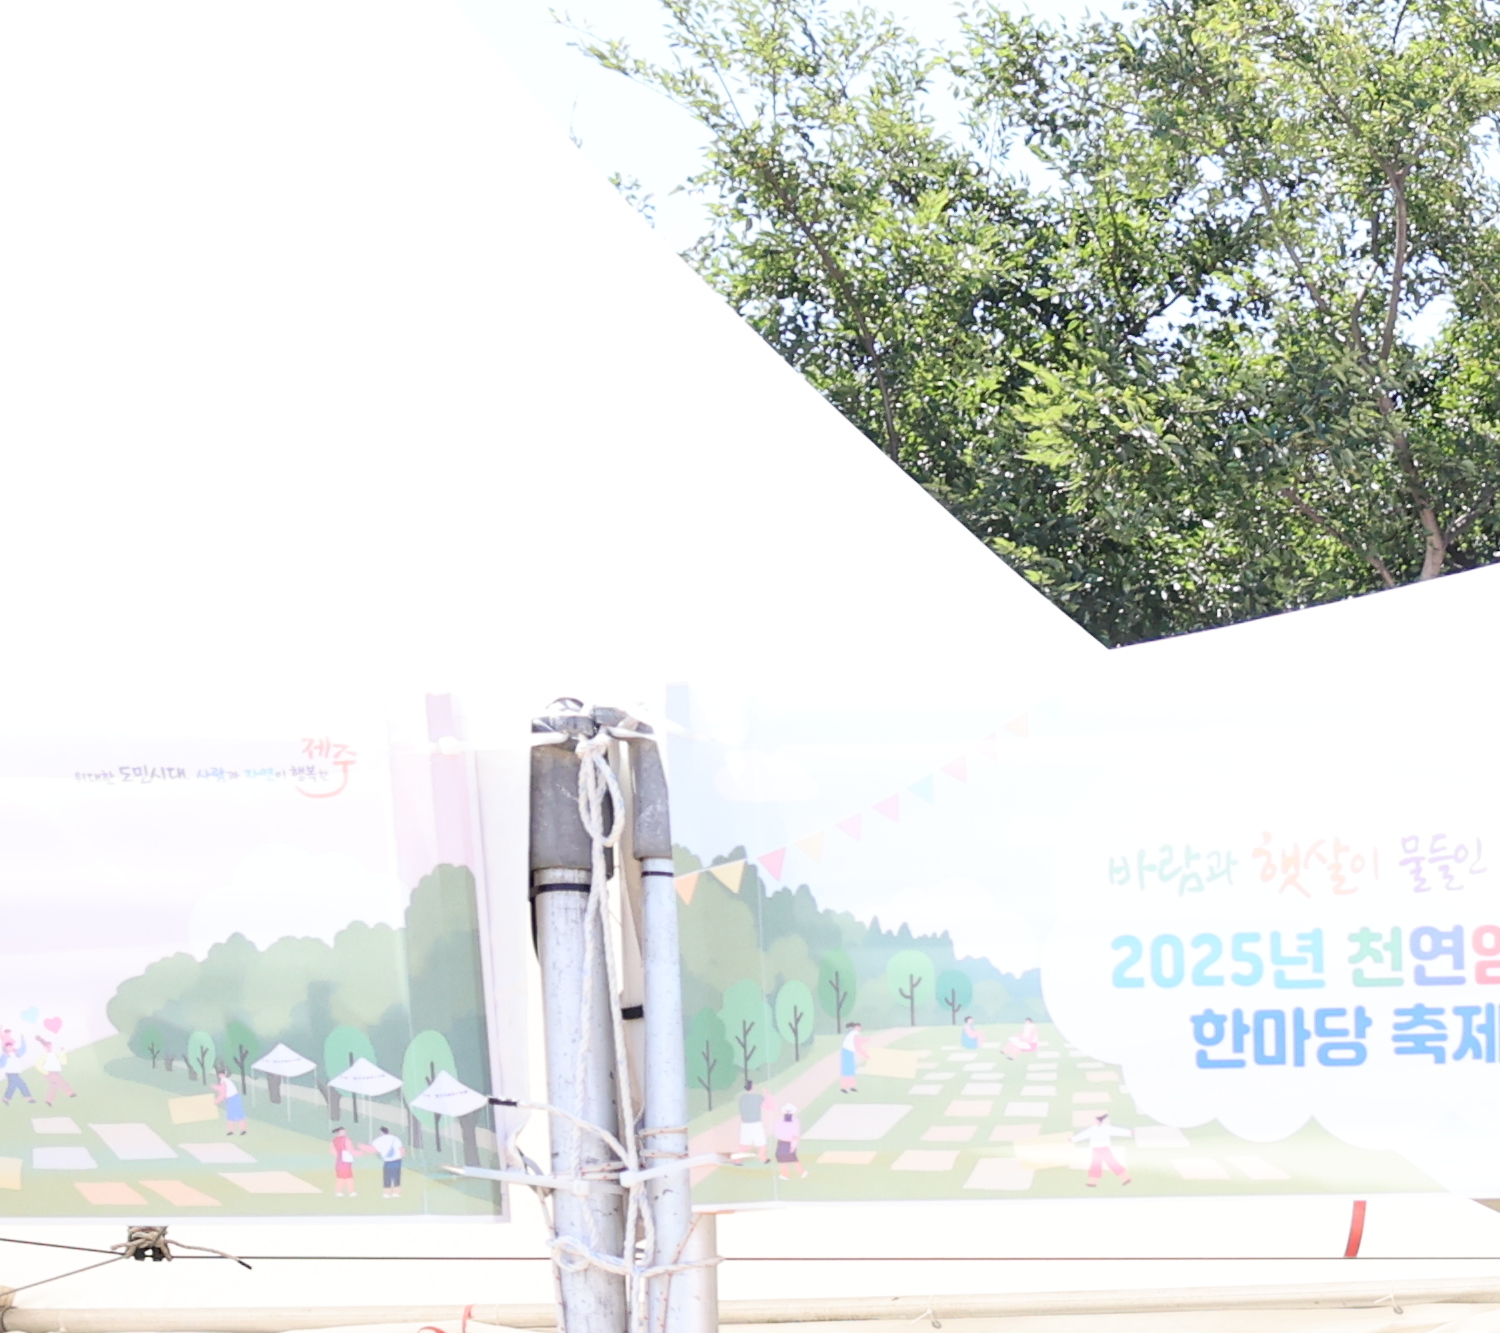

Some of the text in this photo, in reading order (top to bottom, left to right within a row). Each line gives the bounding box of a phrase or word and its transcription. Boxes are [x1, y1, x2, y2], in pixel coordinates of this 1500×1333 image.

[74, 770, 115, 785] 위대한
[196, 767, 240, 782] 사람과
[290, 765, 329, 782] 행복한
[295, 736, 357, 799] 제주
[1108, 843, 1240, 898] 바람과
[1252, 831, 1380, 899] 햇살이
[1398, 833, 1488, 893] 물들인
[1110, 927, 1327, 990] 2025년
[1189, 1005, 1374, 1070] 한마당
